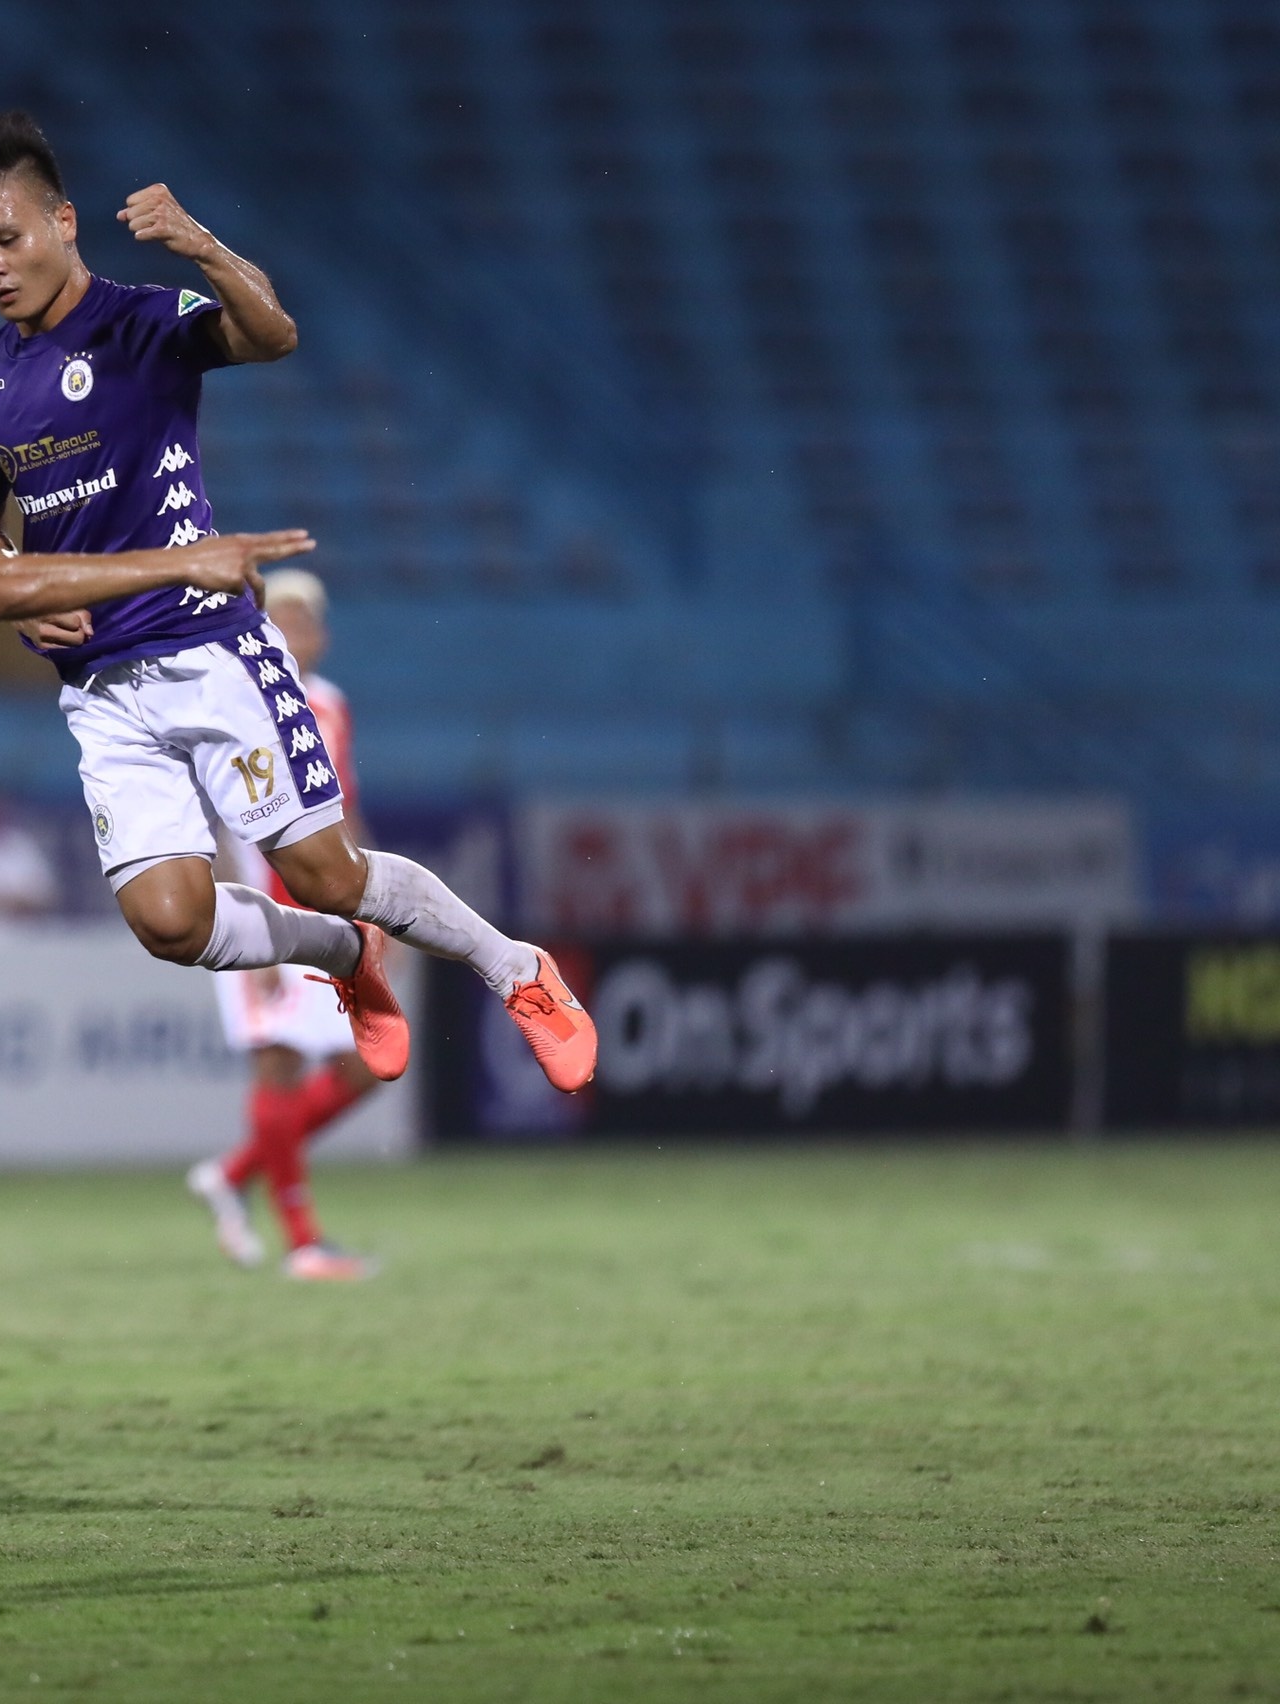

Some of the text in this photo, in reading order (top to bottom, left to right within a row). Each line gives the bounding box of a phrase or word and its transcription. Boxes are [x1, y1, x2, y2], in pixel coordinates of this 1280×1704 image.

[15, 468, 119, 515] Vinawind
[230, 746, 275, 804] 19
[239, 792, 291, 826] Kappa
[598, 958, 1032, 1116] OnSports
